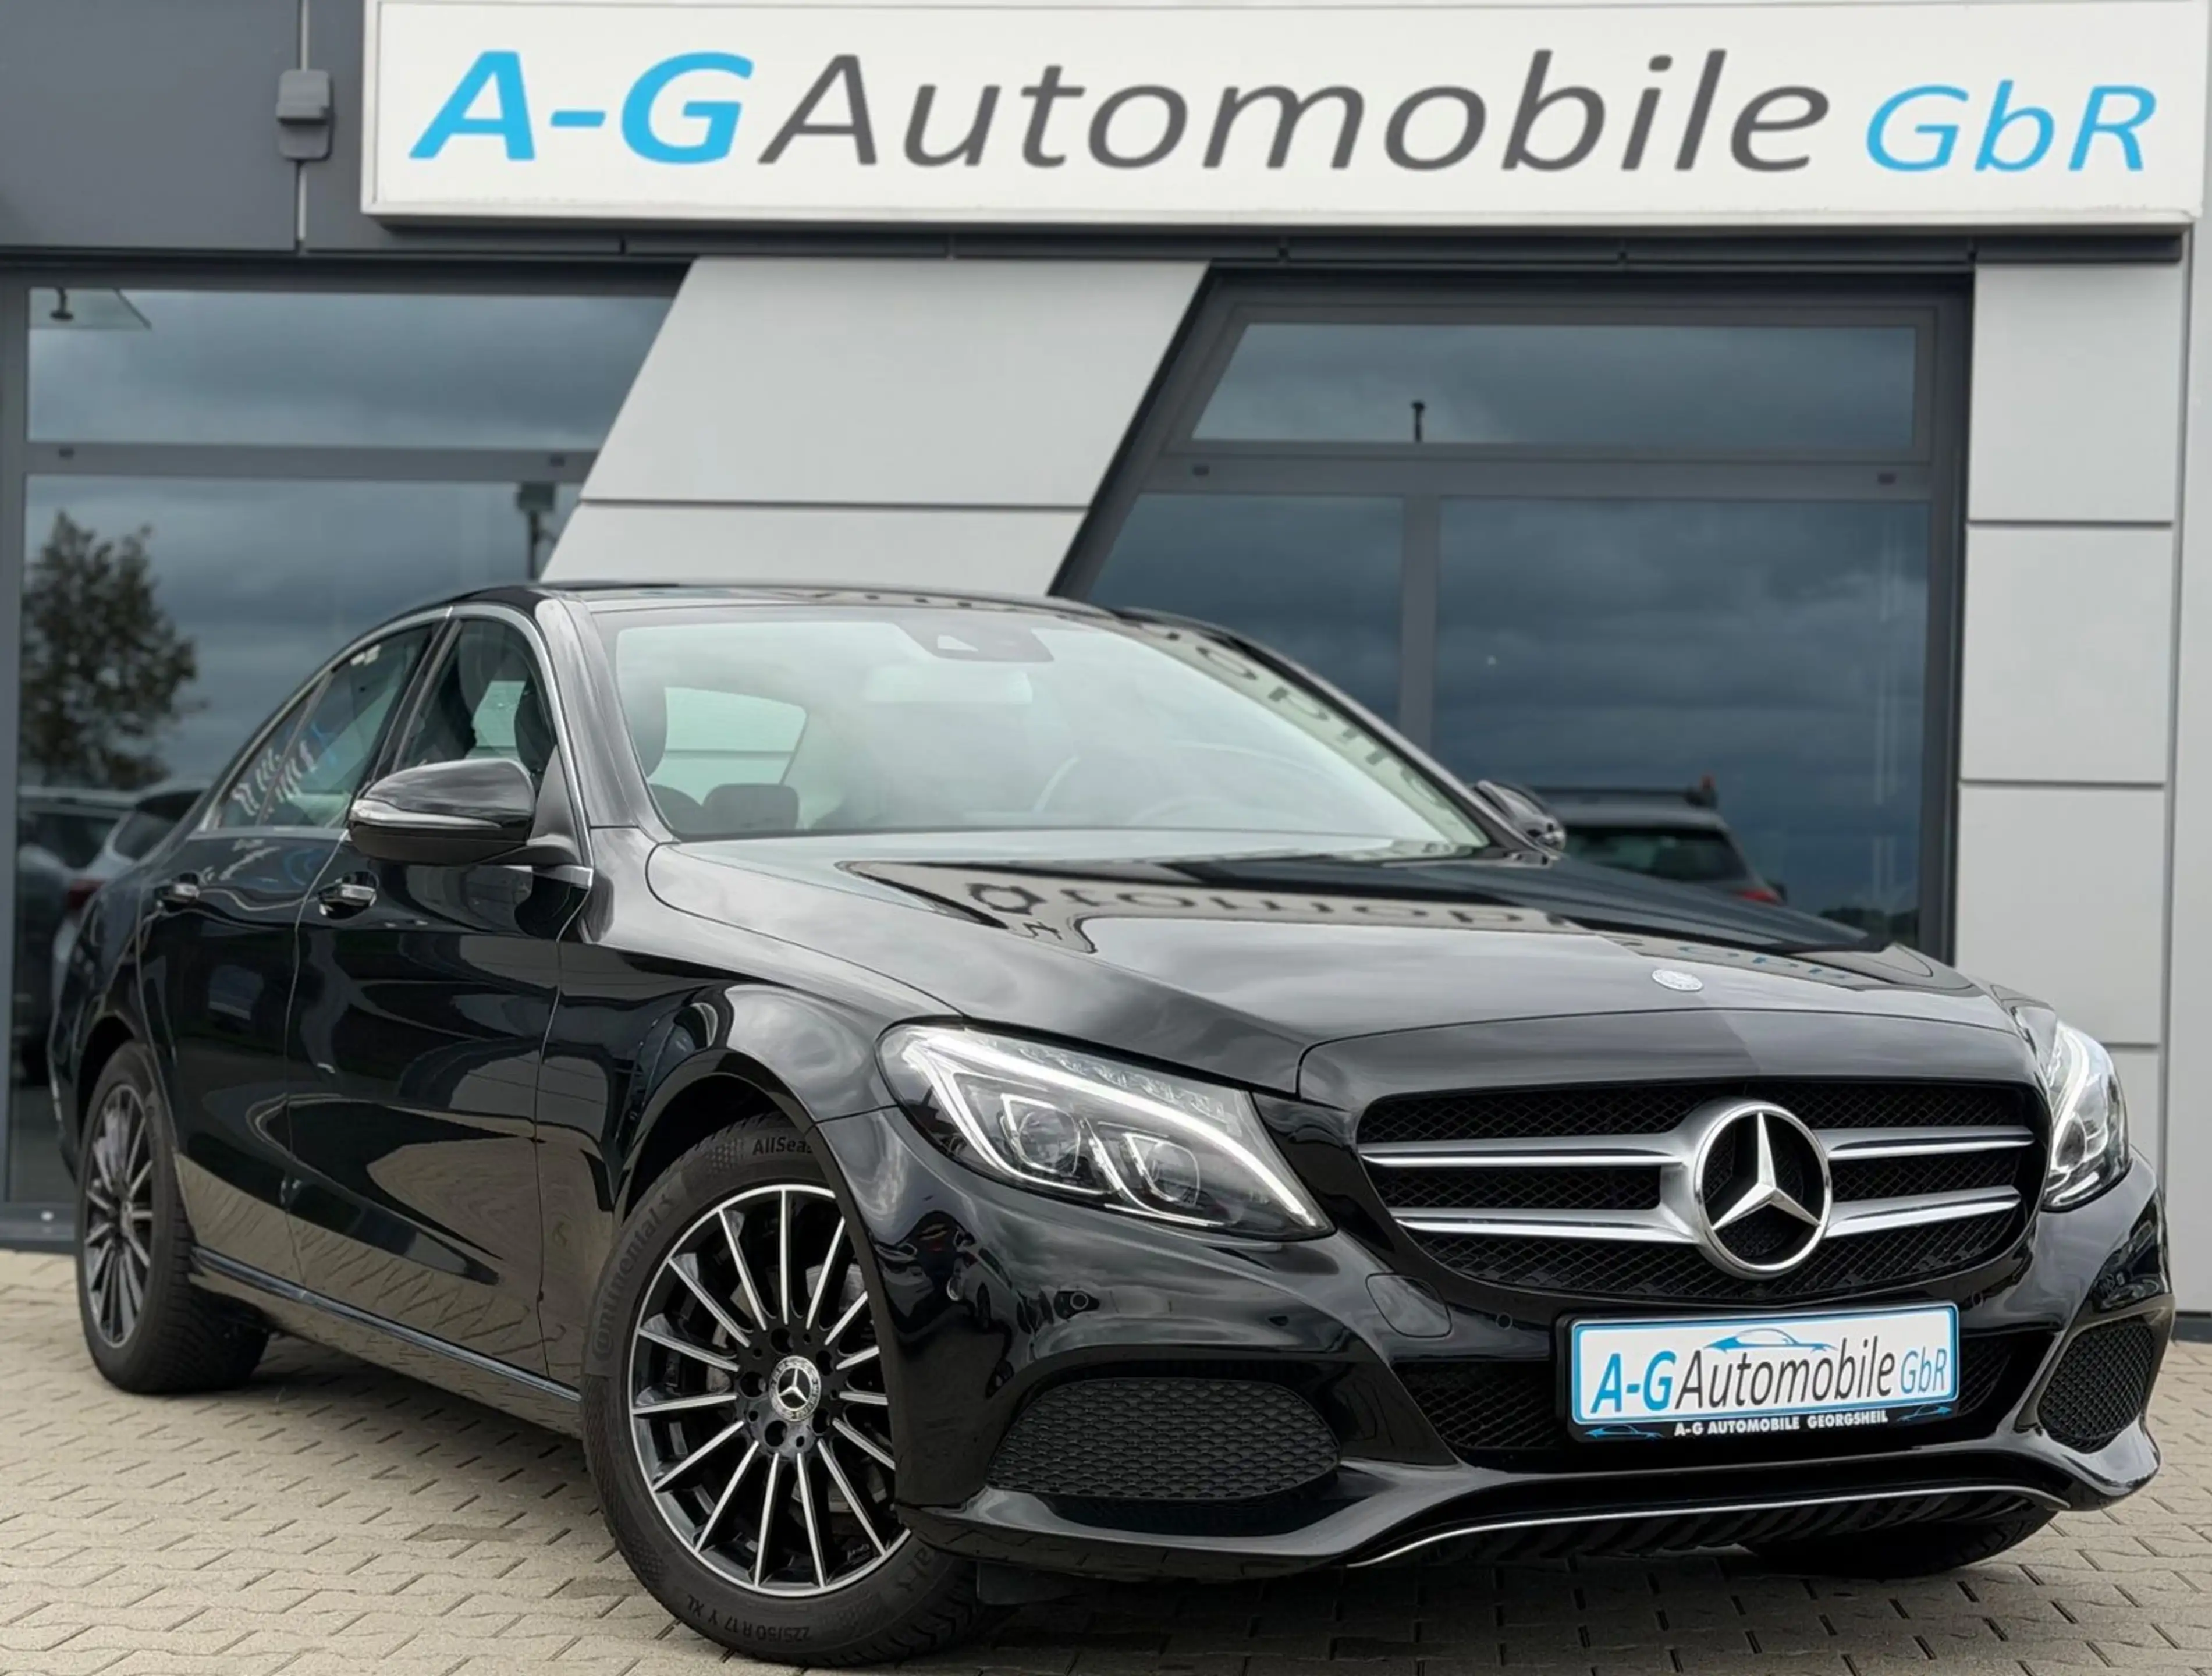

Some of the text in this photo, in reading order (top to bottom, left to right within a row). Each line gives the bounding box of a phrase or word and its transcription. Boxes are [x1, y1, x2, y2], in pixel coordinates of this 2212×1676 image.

[1867, 80, 2156, 171] GbR
[1900, 1345, 1947, 1395] GbR
[1674, 1409, 1888, 1436] A-G AUTOMOBILE GEORGSHEIL
